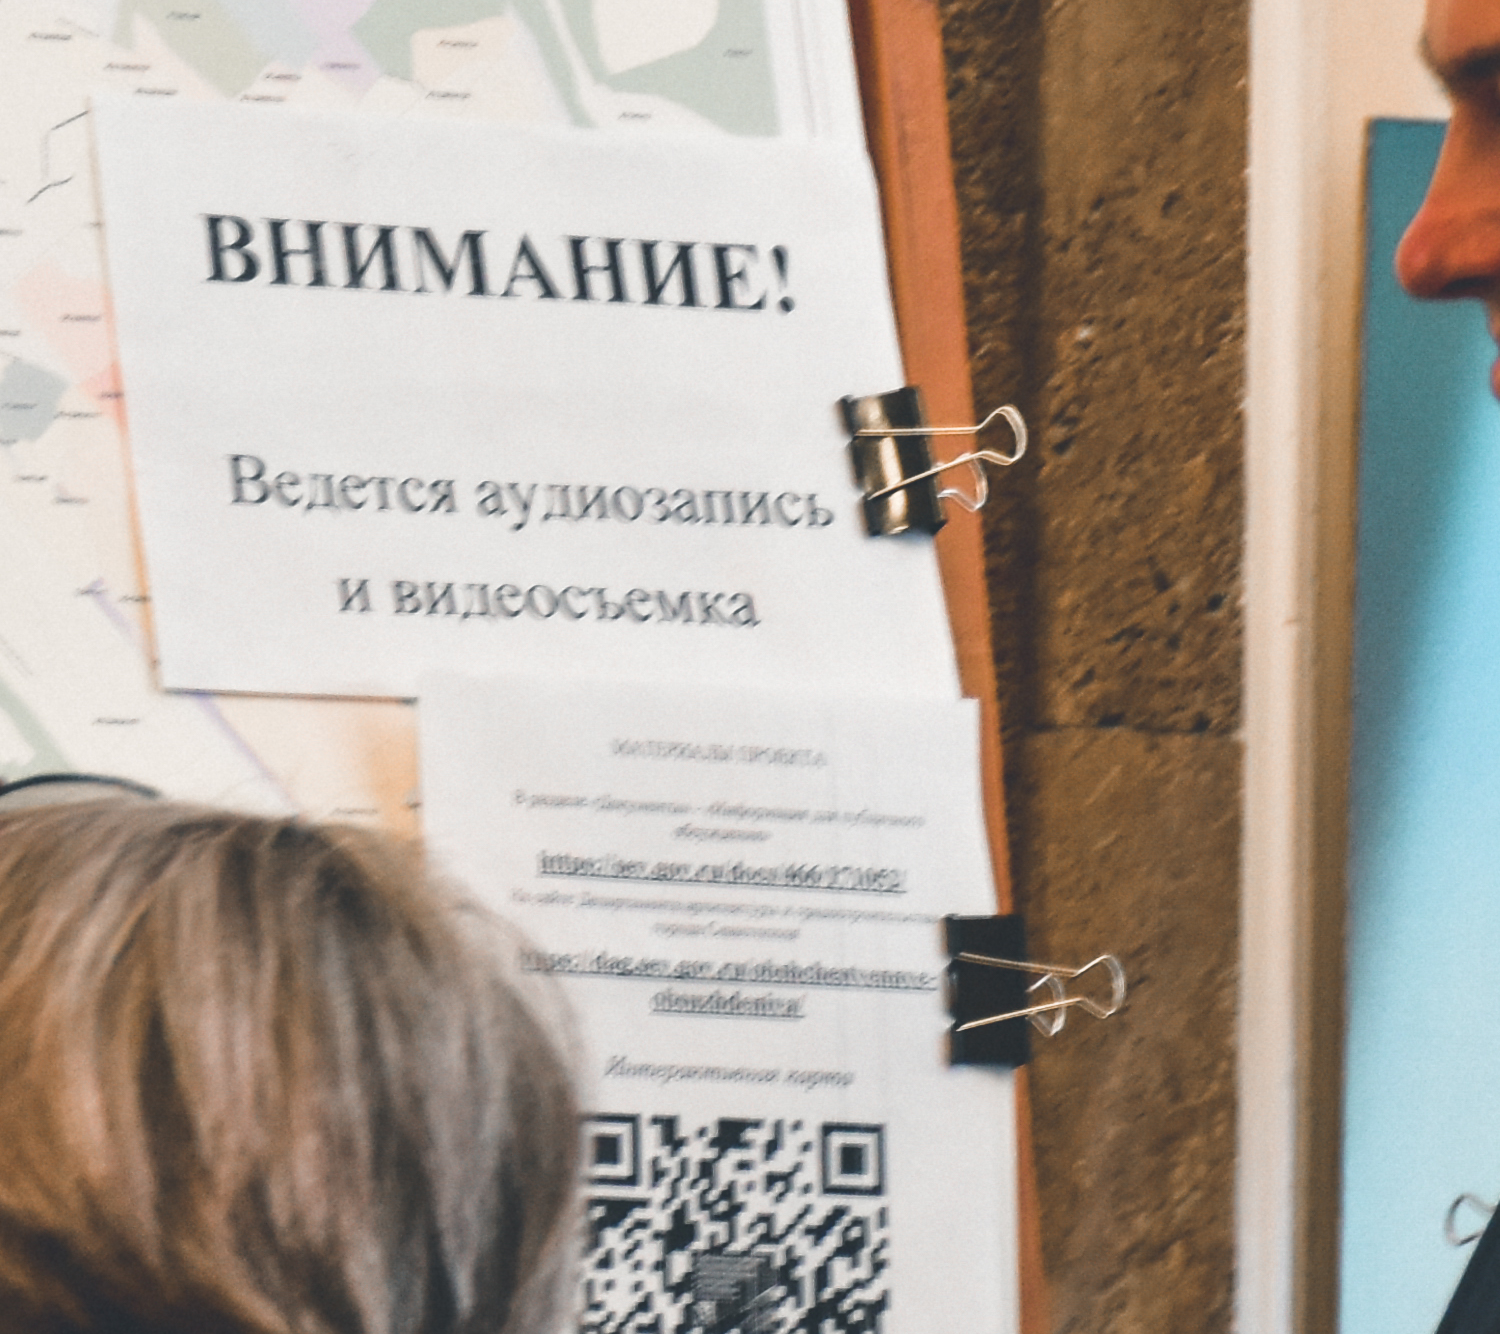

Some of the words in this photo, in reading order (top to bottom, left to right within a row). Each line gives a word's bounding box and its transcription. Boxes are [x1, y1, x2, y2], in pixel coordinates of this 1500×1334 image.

[201, 213, 797, 313] ВНИМАНИЕ!
[228, 453, 459, 518] Ведется
[477, 477, 836, 532] аудиозапись
[337, 577, 374, 614] и
[393, 578, 762, 629] видеосъемка
